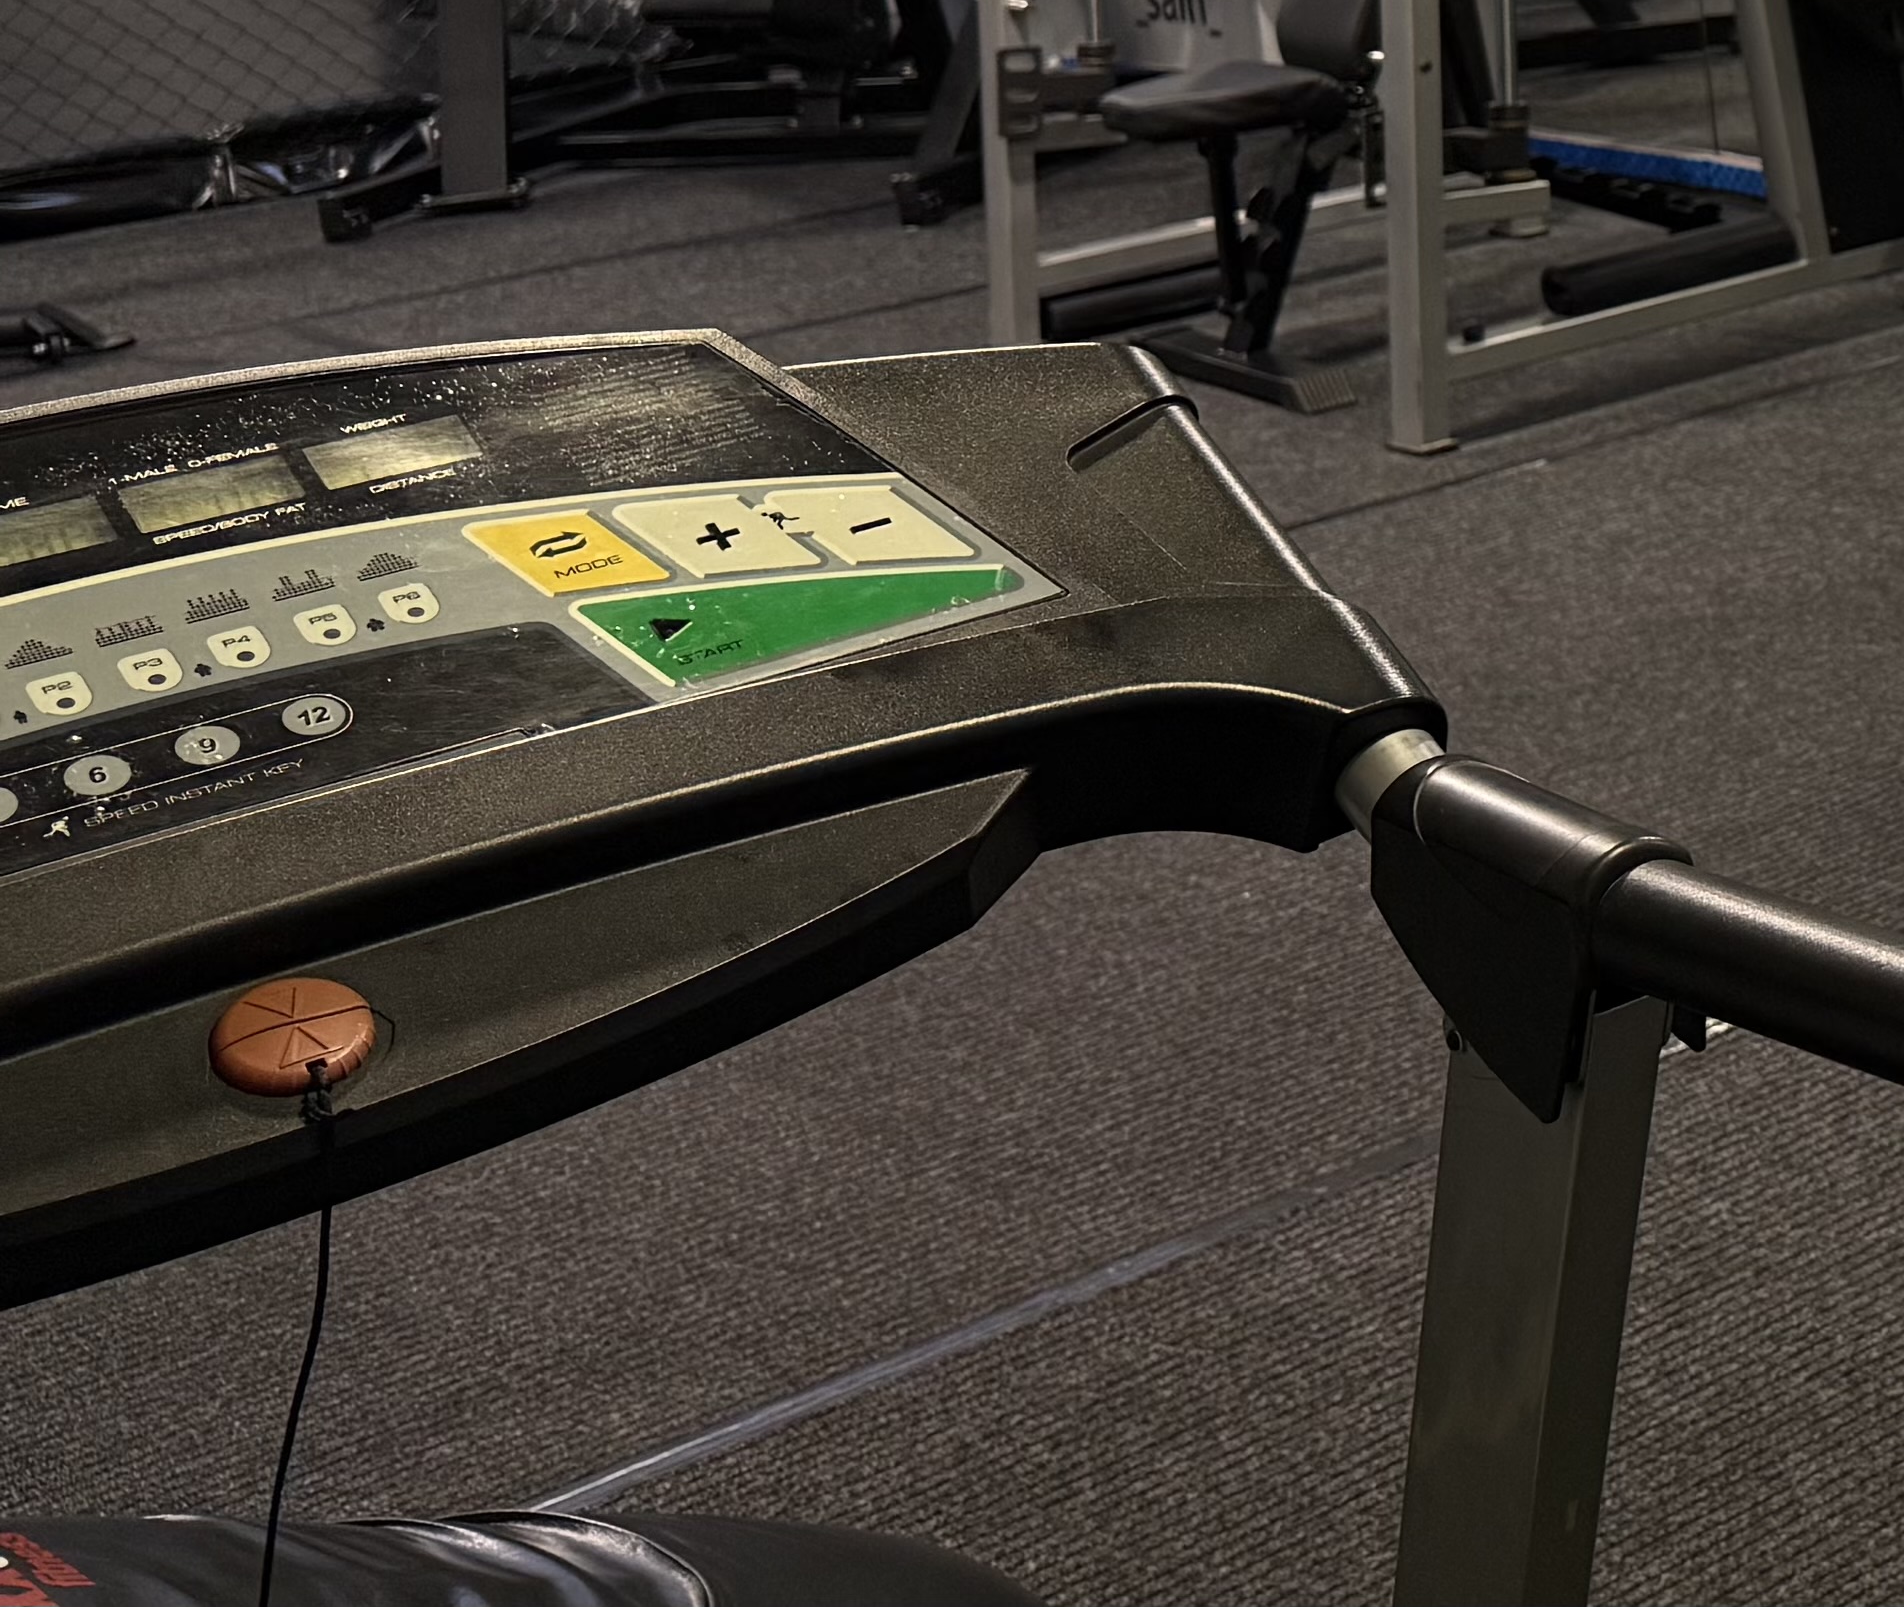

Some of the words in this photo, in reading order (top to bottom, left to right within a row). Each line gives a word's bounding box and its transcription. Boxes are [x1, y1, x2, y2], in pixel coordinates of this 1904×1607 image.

[339, 412, 407, 434] WEIGHT
[368, 467, 457, 494] DISTANCE
[274, 501, 307, 518] FAT
[553, 554, 625, 580] MODE
[221, 633, 252, 650] P4
[676, 638, 745, 667] START
[132, 656, 164, 674] P3
[40, 679, 74, 695] P2
[88, 766, 108, 784] 6
[199, 737, 218, 755] 9
[296, 706, 331, 726] 12
[83, 800, 159, 828] SPEED
[165, 772, 256, 805] INSTANT
[262, 757, 305, 779] KEY
